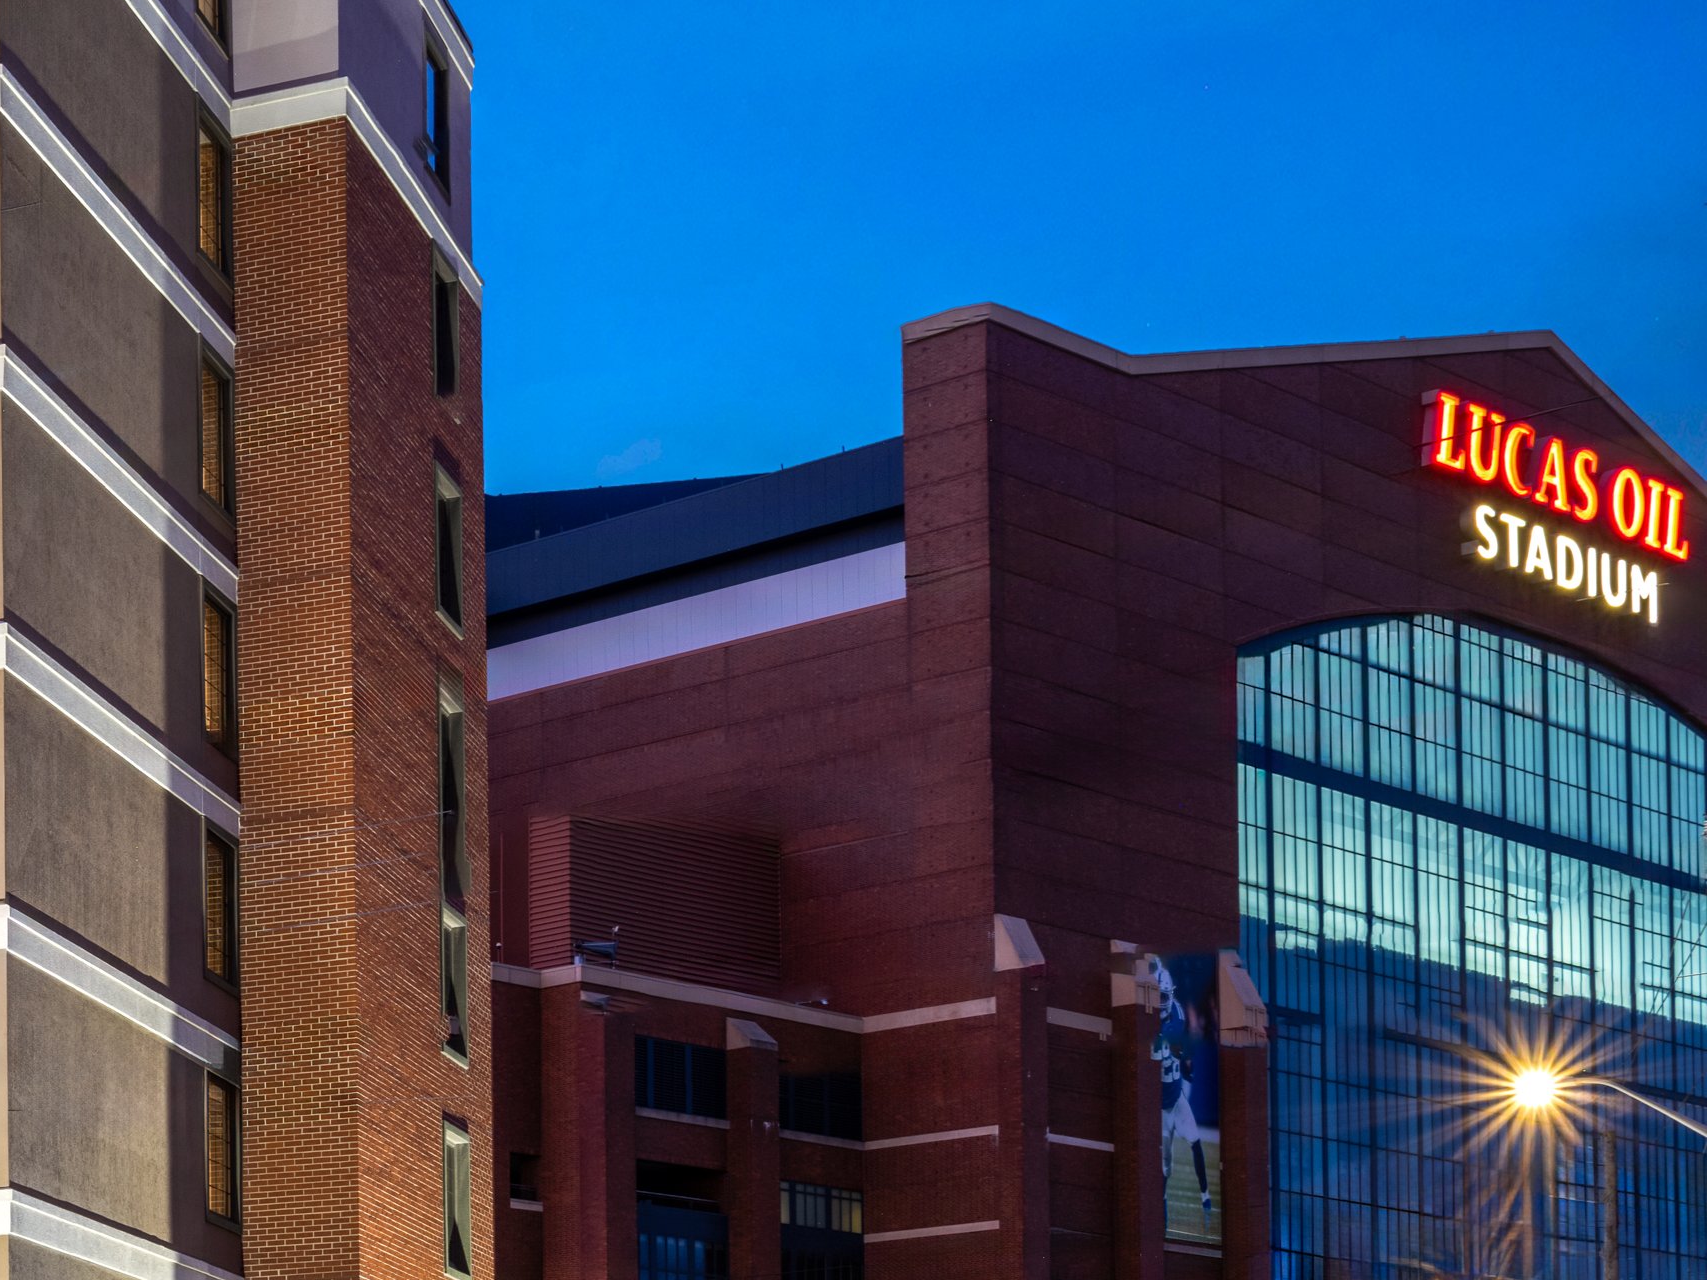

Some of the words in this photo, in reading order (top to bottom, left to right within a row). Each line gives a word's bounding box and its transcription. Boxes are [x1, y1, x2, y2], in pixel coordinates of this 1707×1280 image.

[1436, 391, 1598, 521] LUCAS
[1612, 467, 1689, 561] OIL
[1475, 504, 1659, 624] STADIUM
